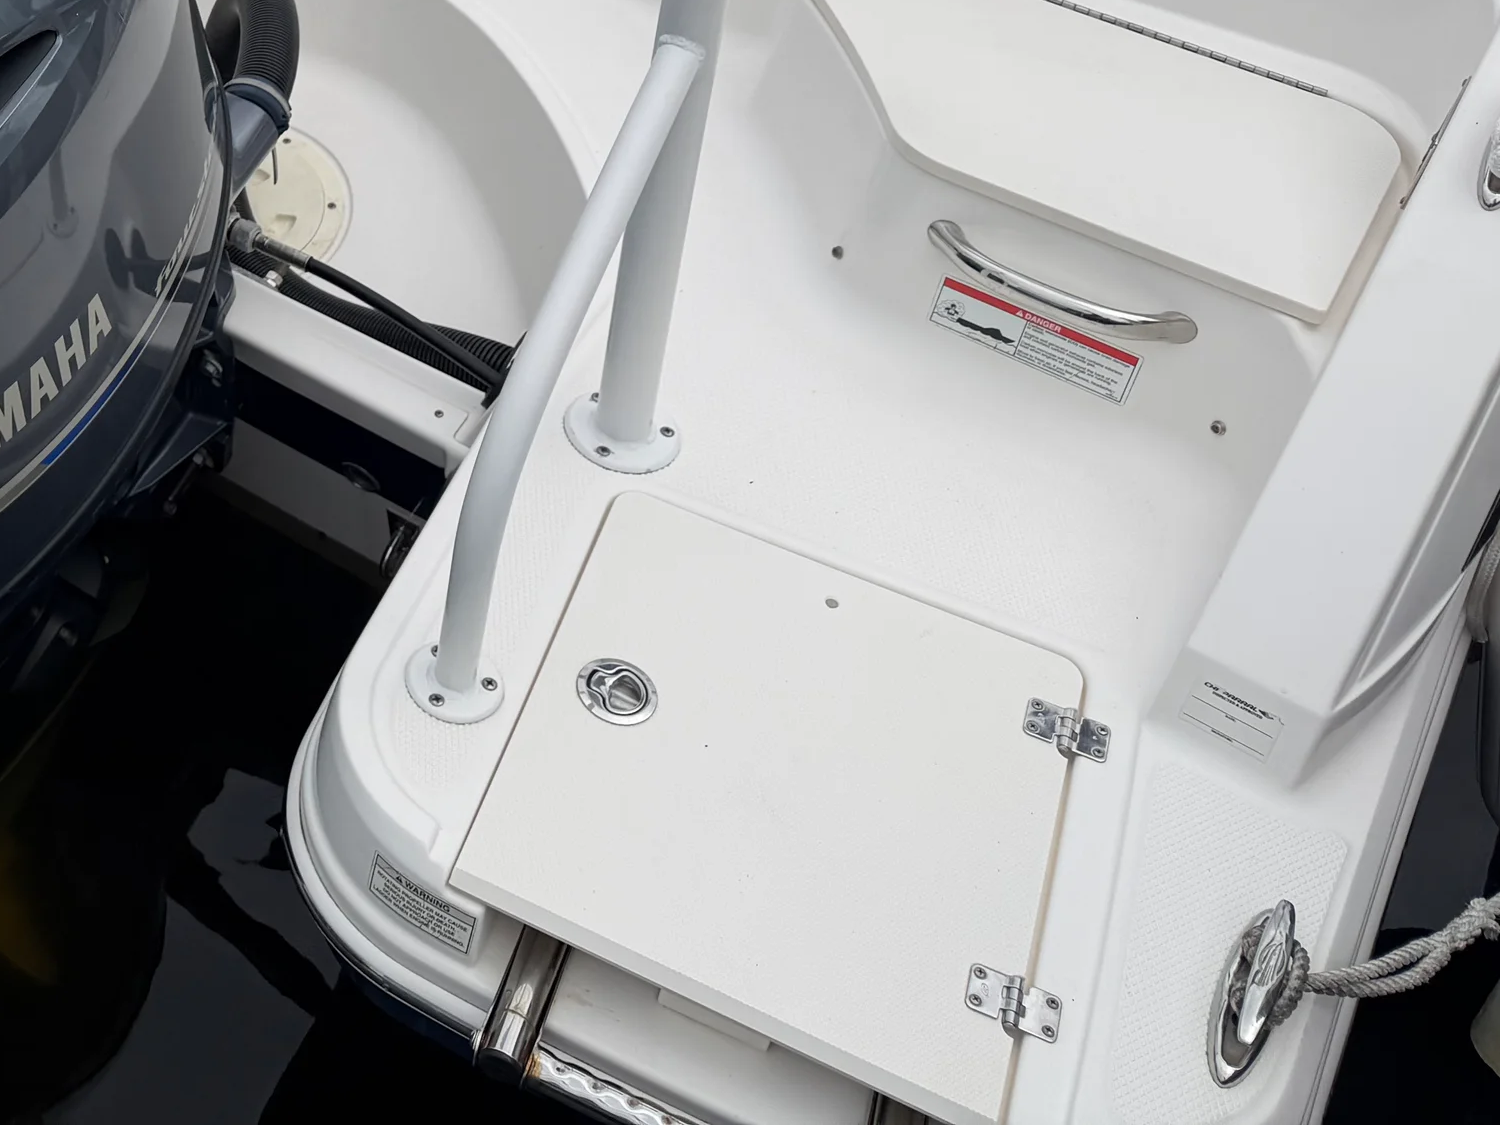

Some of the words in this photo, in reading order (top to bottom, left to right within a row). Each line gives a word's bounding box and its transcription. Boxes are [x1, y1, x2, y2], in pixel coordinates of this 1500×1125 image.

[1024, 313, 1061, 333] DANGER
[1204, 682, 1258, 712] CHPARRAL
[402, 890, 434, 914] PROPELLER
[405, 880, 450, 912] WARNING
[402, 903, 433, 925] APPROACH
